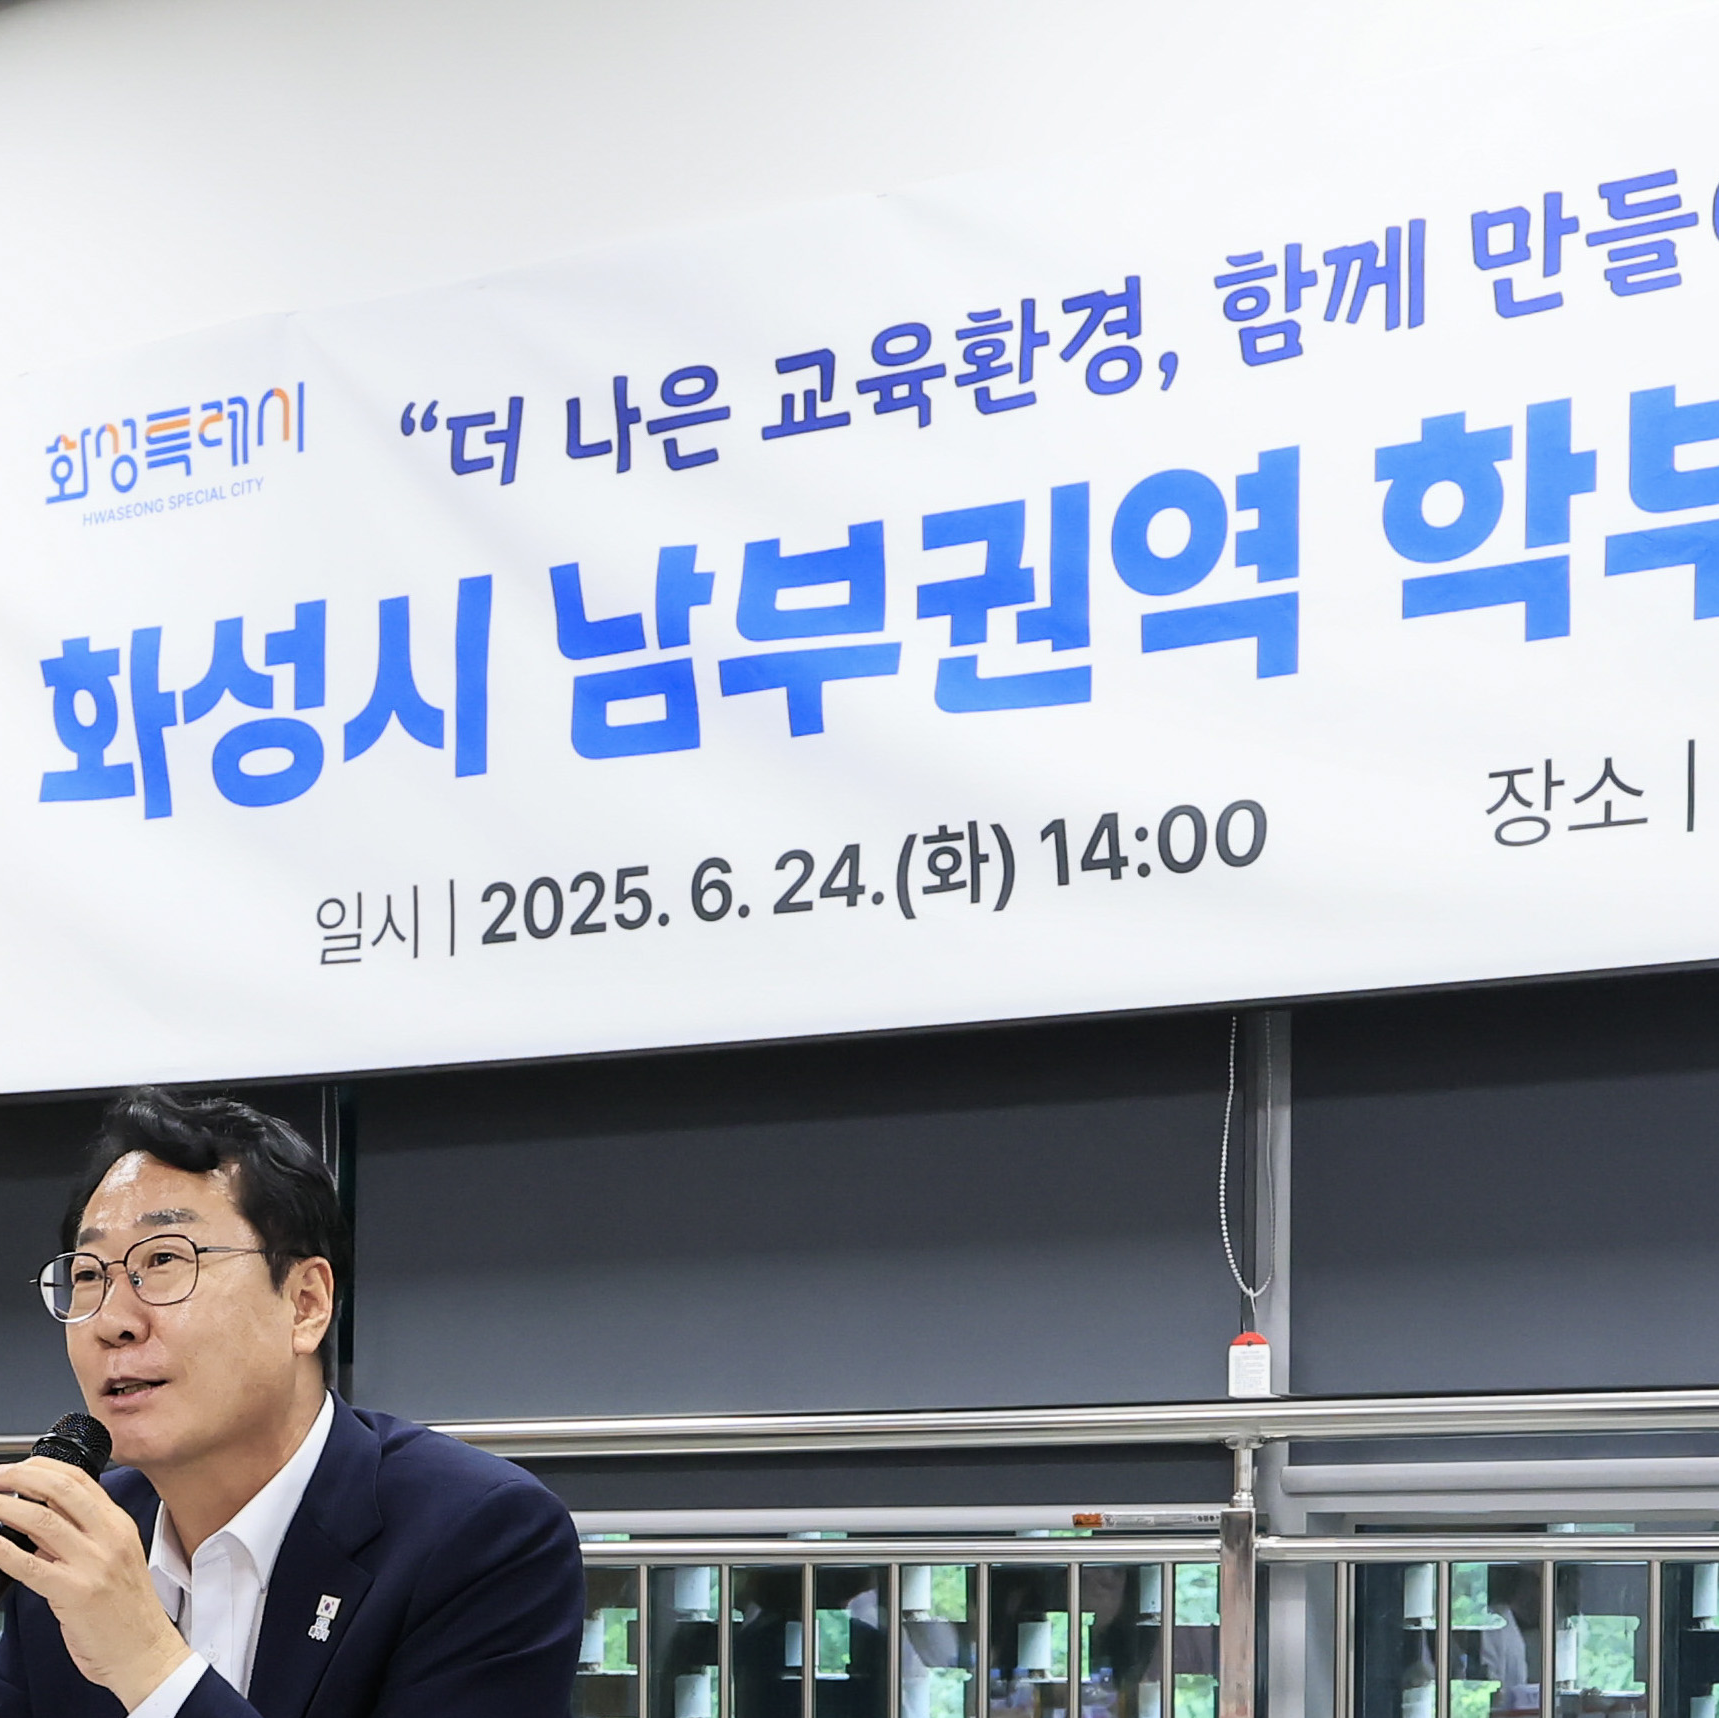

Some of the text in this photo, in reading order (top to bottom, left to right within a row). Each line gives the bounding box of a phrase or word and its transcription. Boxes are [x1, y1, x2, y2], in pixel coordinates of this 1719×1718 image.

[566, 365, 730, 474] 나은
[762, 276, 1178, 440] 교육환경,
[1214, 219, 1425, 366] 함께
[83, 476, 265, 527] HWASEONG SPECIAL CITY
[40, 575, 492, 819] 화성시
[549, 446, 1299, 759] 남부권역
[317, 885, 418, 964] 일시
[482, 866, 669, 945] 2025.
[691, 857, 750, 922] 6.
[1041, 800, 1267, 886] 14:00
[1486, 758, 1647, 846] 장소
